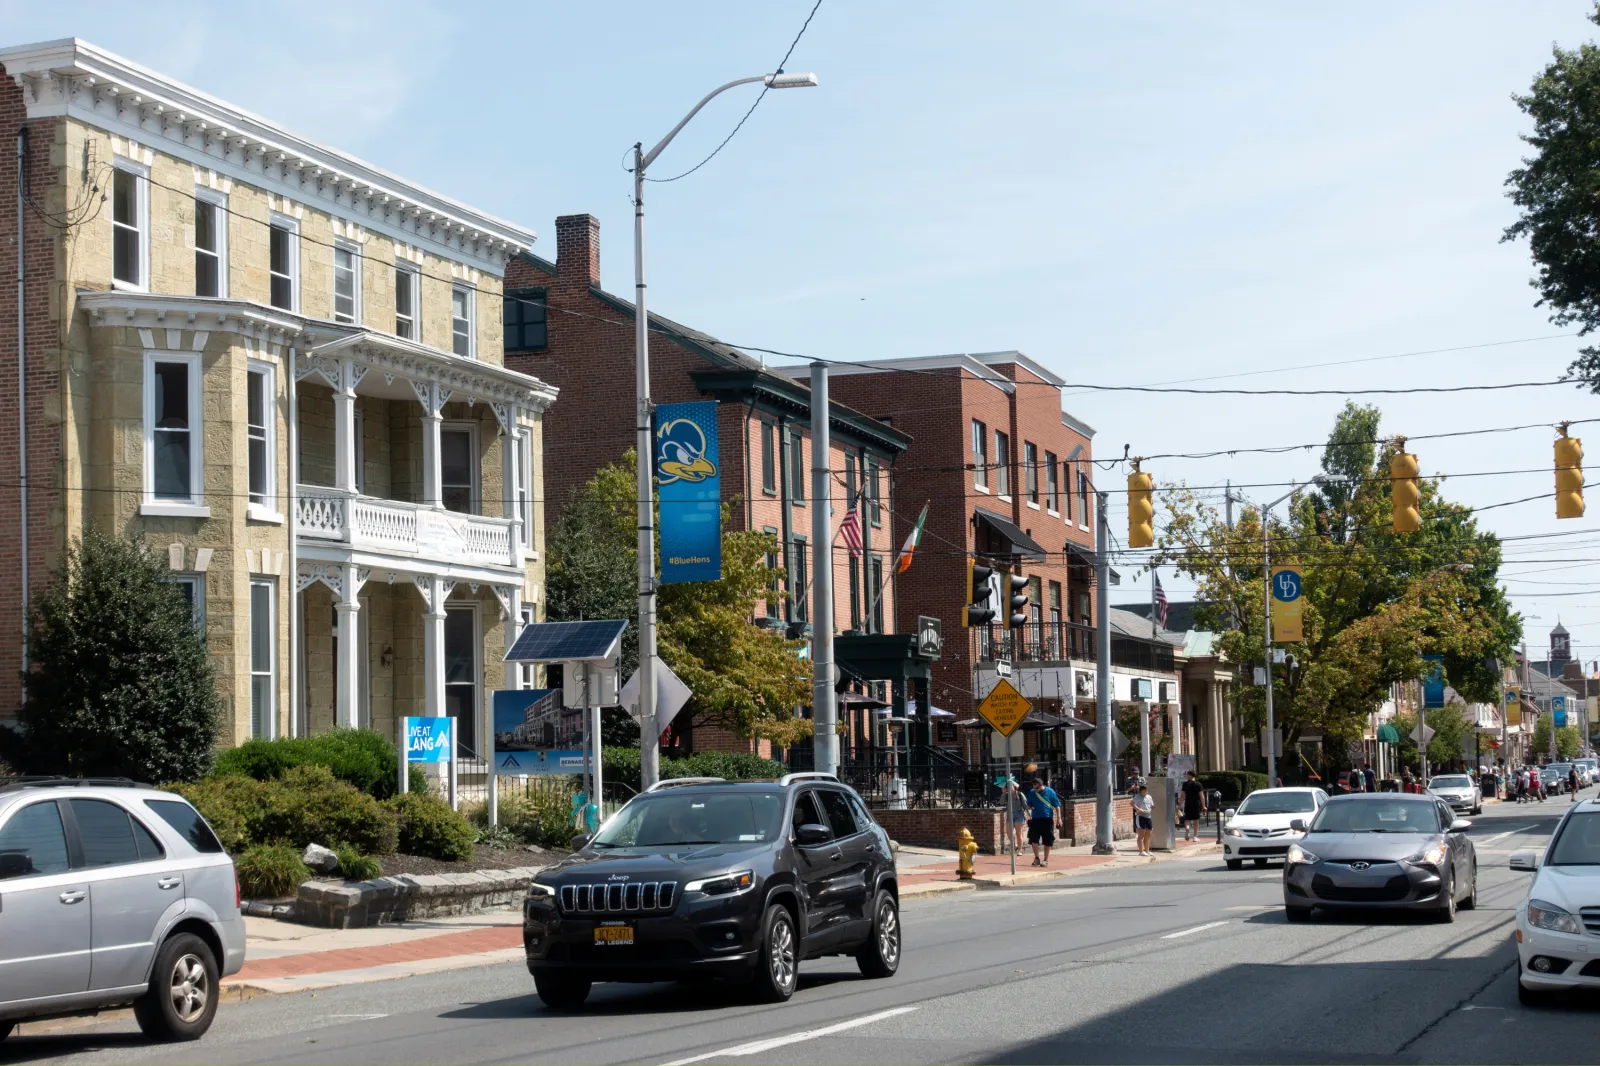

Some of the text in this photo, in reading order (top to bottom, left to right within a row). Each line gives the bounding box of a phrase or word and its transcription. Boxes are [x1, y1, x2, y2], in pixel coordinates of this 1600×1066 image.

[669, 556, 711, 565] #BlueHens
[1278, 574, 1297, 598] UD
[990, 693, 1018, 701] CAUTION
[422, 726, 431, 736] AT
[408, 737, 434, 751] LANG
